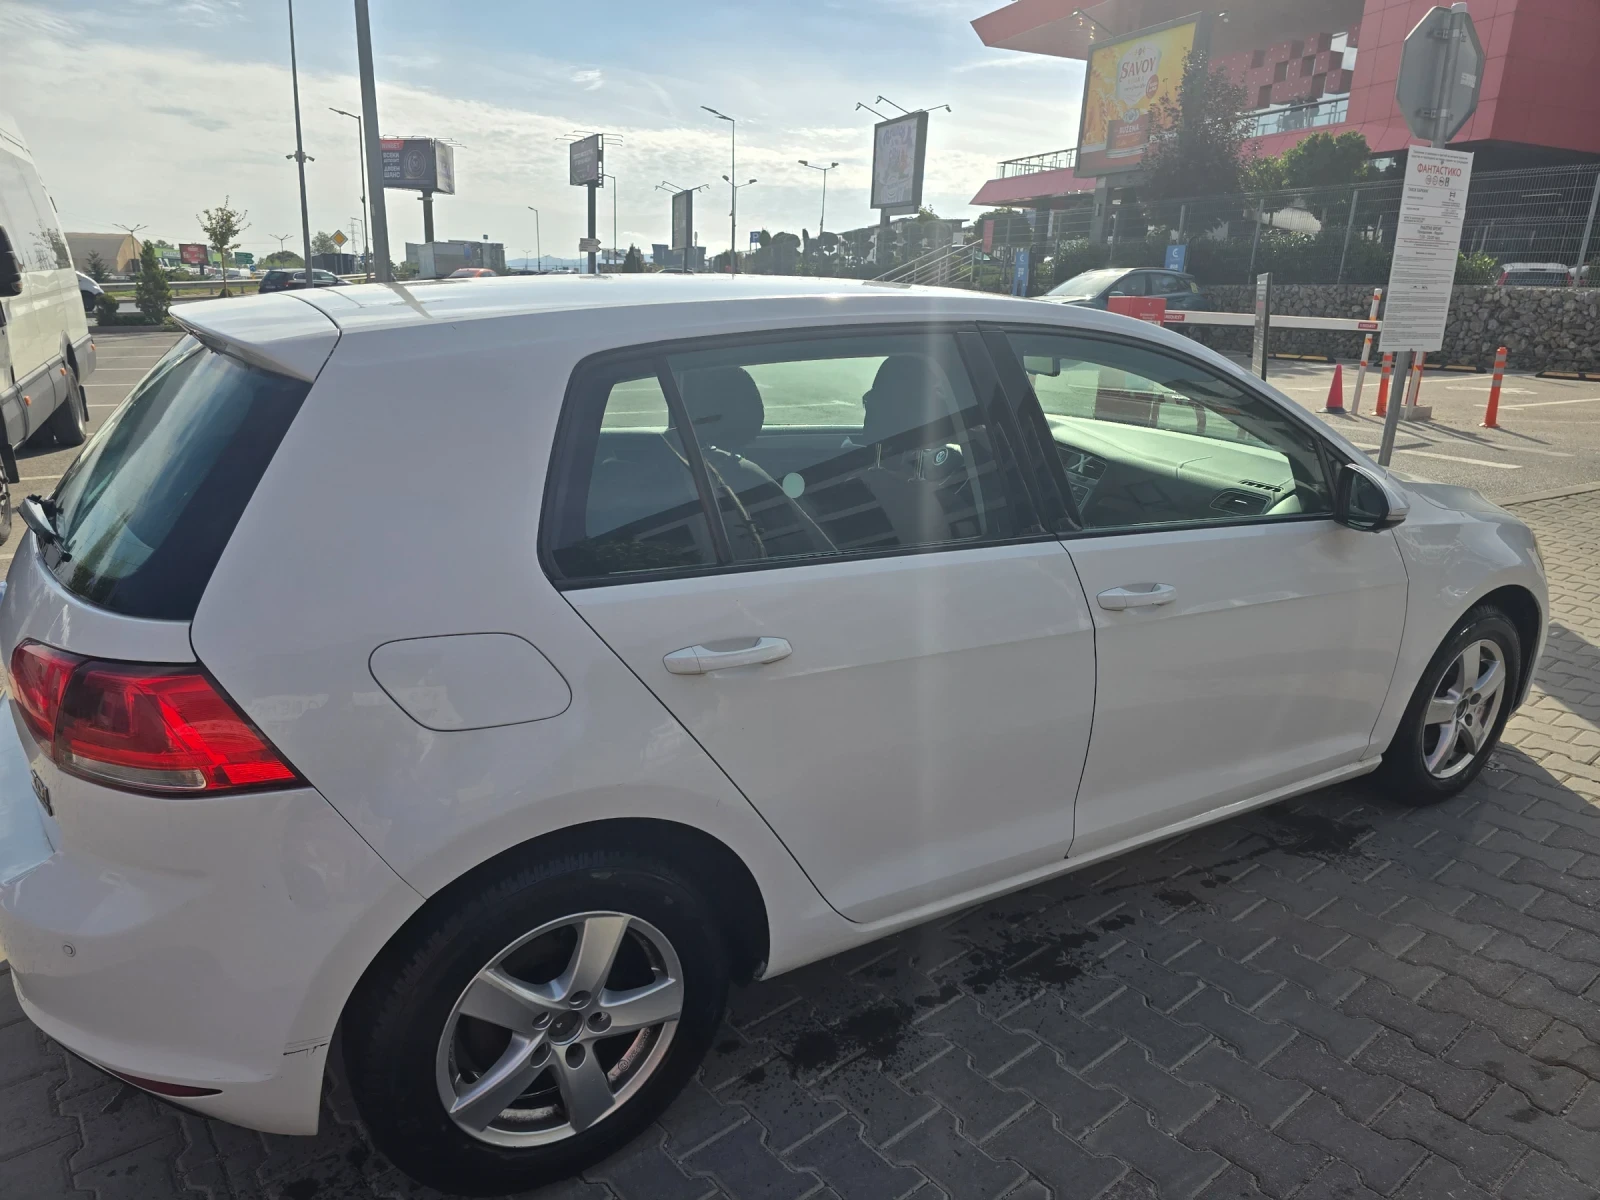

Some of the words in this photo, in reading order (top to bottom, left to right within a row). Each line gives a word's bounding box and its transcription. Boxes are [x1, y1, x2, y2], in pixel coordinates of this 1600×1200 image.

[1119, 57, 1156, 82] SAVOY
[1417, 163, 1462, 177] ФАНТАСТИКО
[752, 233, 759, 241] P
